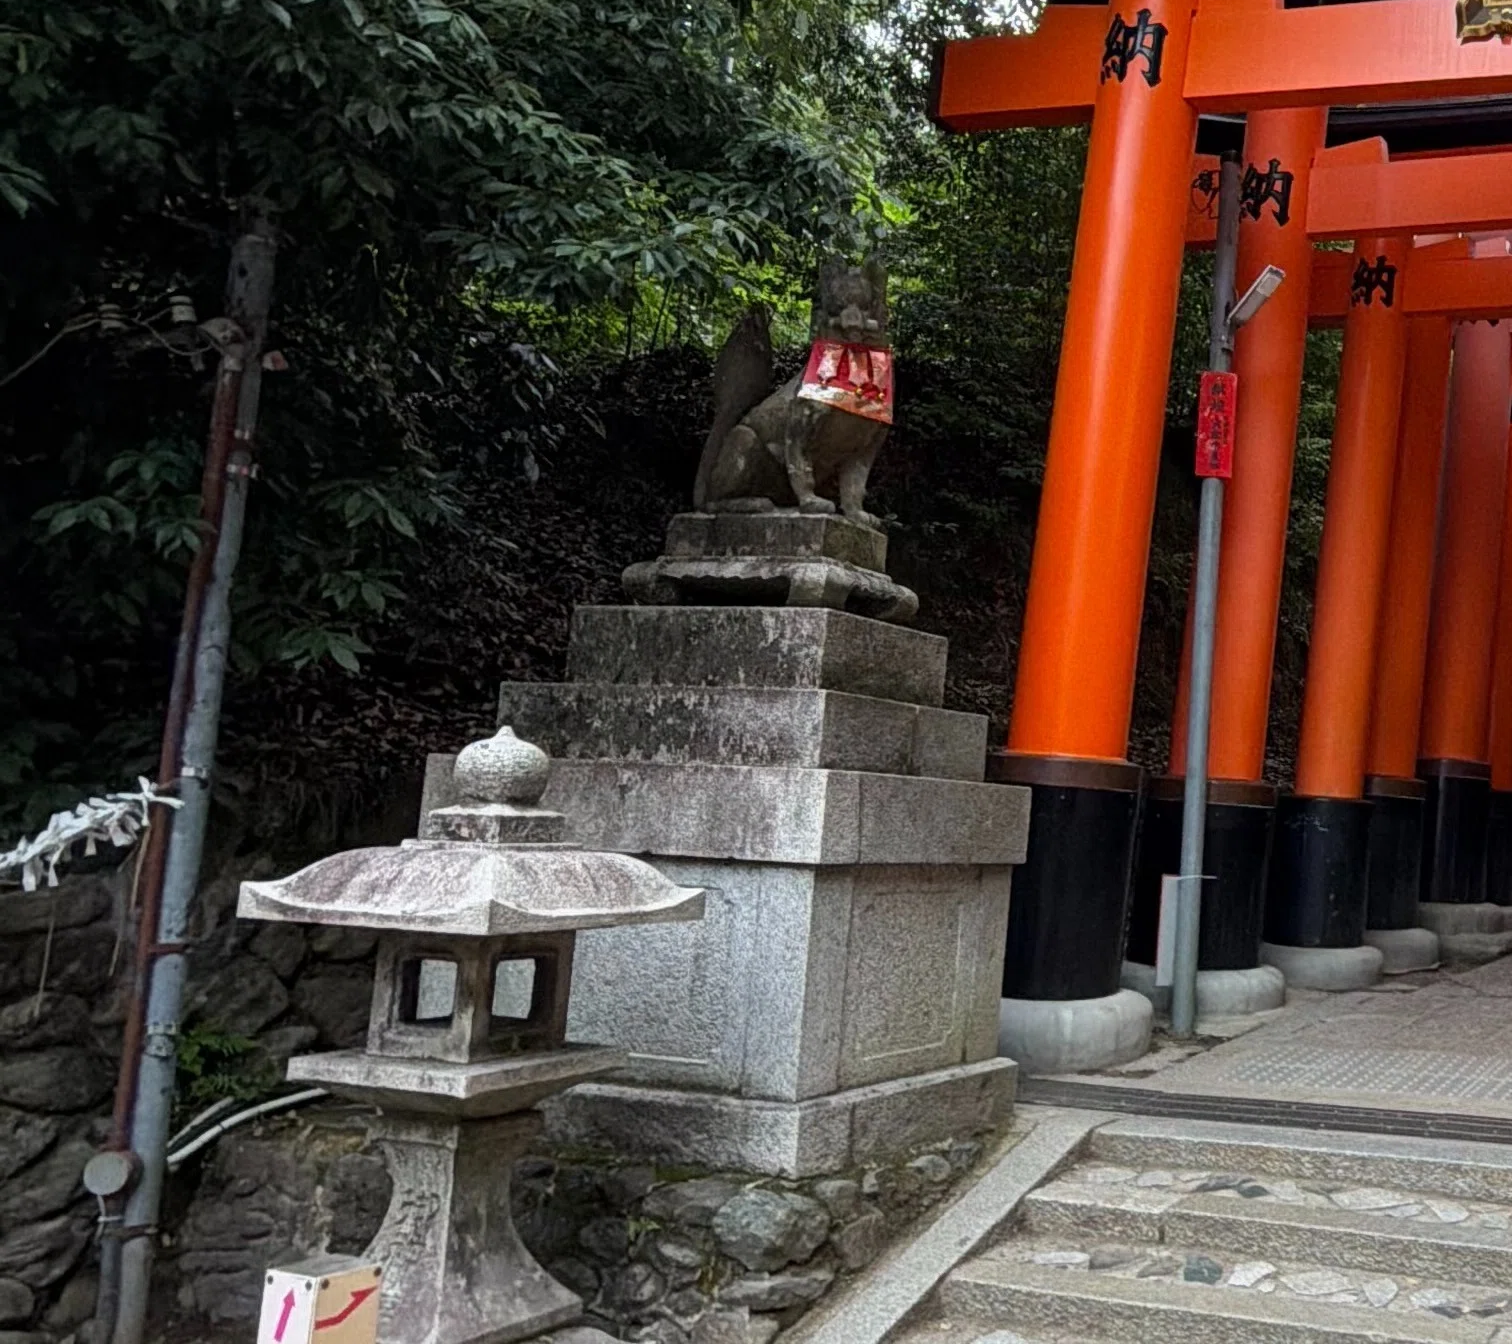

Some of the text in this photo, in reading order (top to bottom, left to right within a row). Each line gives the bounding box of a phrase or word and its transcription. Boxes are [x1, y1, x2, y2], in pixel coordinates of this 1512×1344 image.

[1101, 8, 1168, 87] 納
[1240, 158, 1294, 227] 納
[1351, 255, 1397, 308] 納
